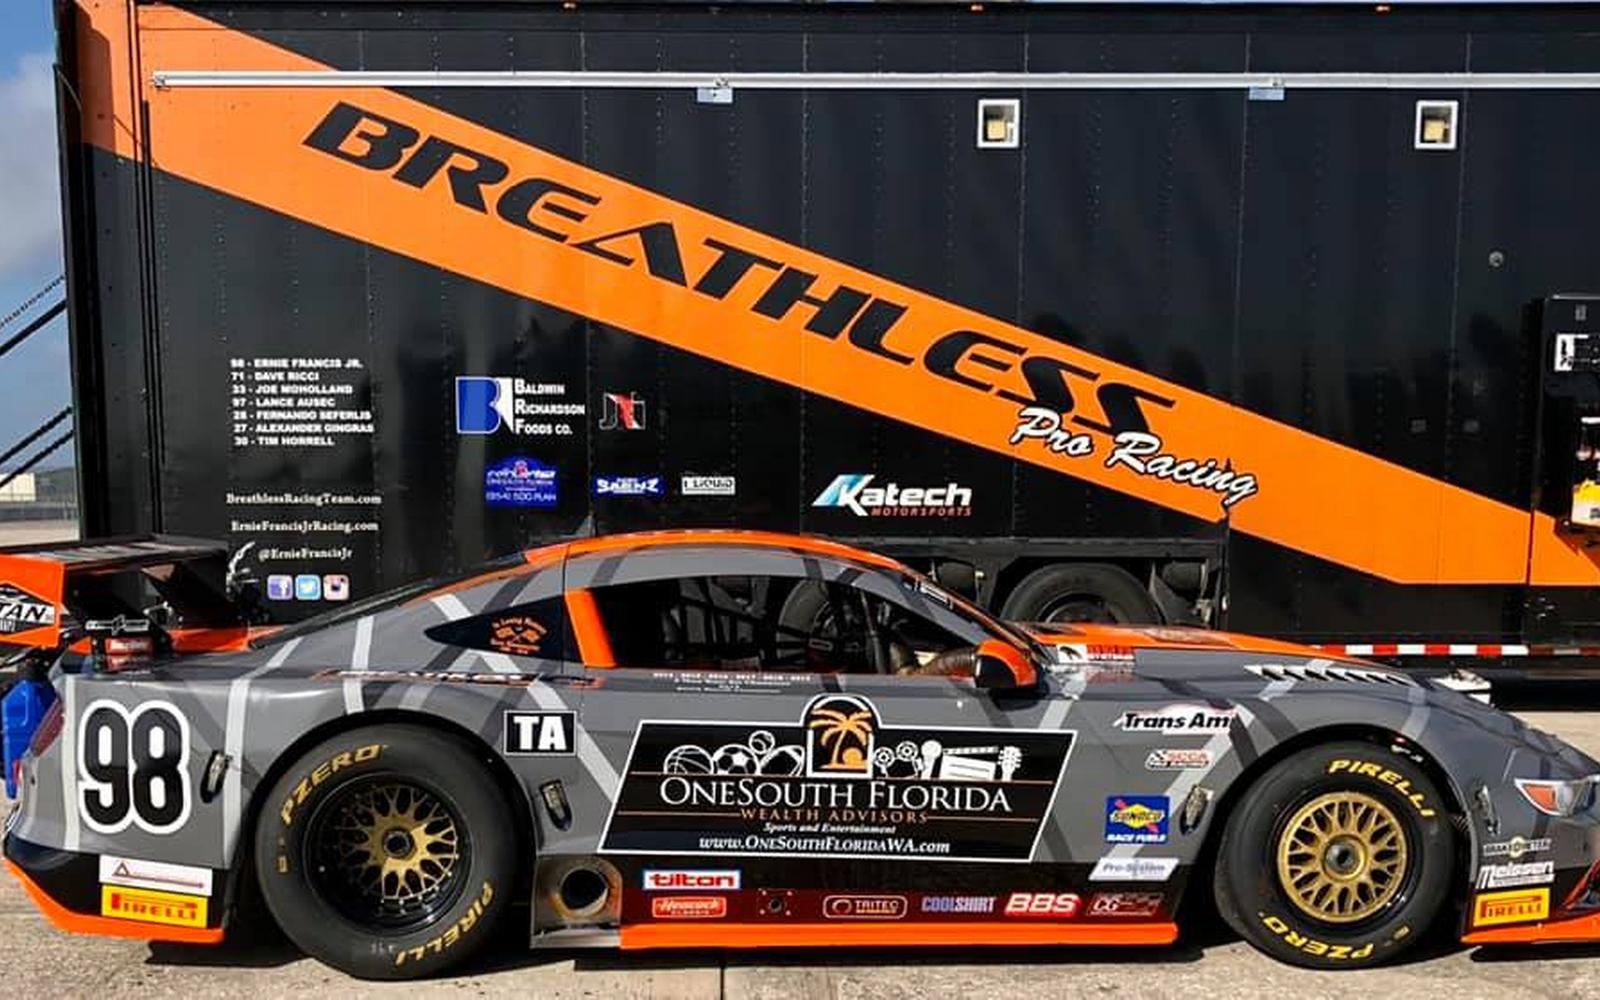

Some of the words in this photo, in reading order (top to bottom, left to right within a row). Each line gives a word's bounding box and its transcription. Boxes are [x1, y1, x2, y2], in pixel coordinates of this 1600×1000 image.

[301, 101, 1176, 437] BREATHLESS
[292, 358, 341, 368] FRANCIS
[231, 371, 244, 381] 71
[254, 371, 285, 381] DAVE
[288, 371, 319, 381] RICCI
[255, 384, 277, 394] JOE
[256, 397, 295, 407] LANCE
[256, 410, 317, 420] FERNANDO
[255, 423, 322, 433] ALEXANDER
[258, 436, 278, 446] TIM
[1011, 406, 1092, 457] Pro
[1106, 432, 1258, 506] Racing
[226, 493, 382, 506] BreathlessRacingTeam.com
[811, 474, 973, 516] Katech
[871, 507, 972, 516] MOTORSPORTS
[231, 521, 379, 533] ErnieFrancisJrRacing.com
[258, 547, 353, 561] @ErnieFrancisJr
[1123, 712, 1186, 730] Trans
[1188, 711, 1231, 730] Am
[513, 715, 568, 751] TA
[80, 703, 188, 830] 98
[1328, 759, 1436, 817] PIRELLI
[740, 808, 819, 823] WEALTH
[828, 809, 928, 824] ADVISORS
[763, 822, 797, 833] Sports
[799, 824, 820, 833] and
[821, 824, 896, 834] Entertainment
[651, 873, 735, 887] tilton
[921, 896, 996, 913] COOLSHIRT
[1005, 893, 1081, 917] BBS
[394, 879, 494, 966] PIRELLI
